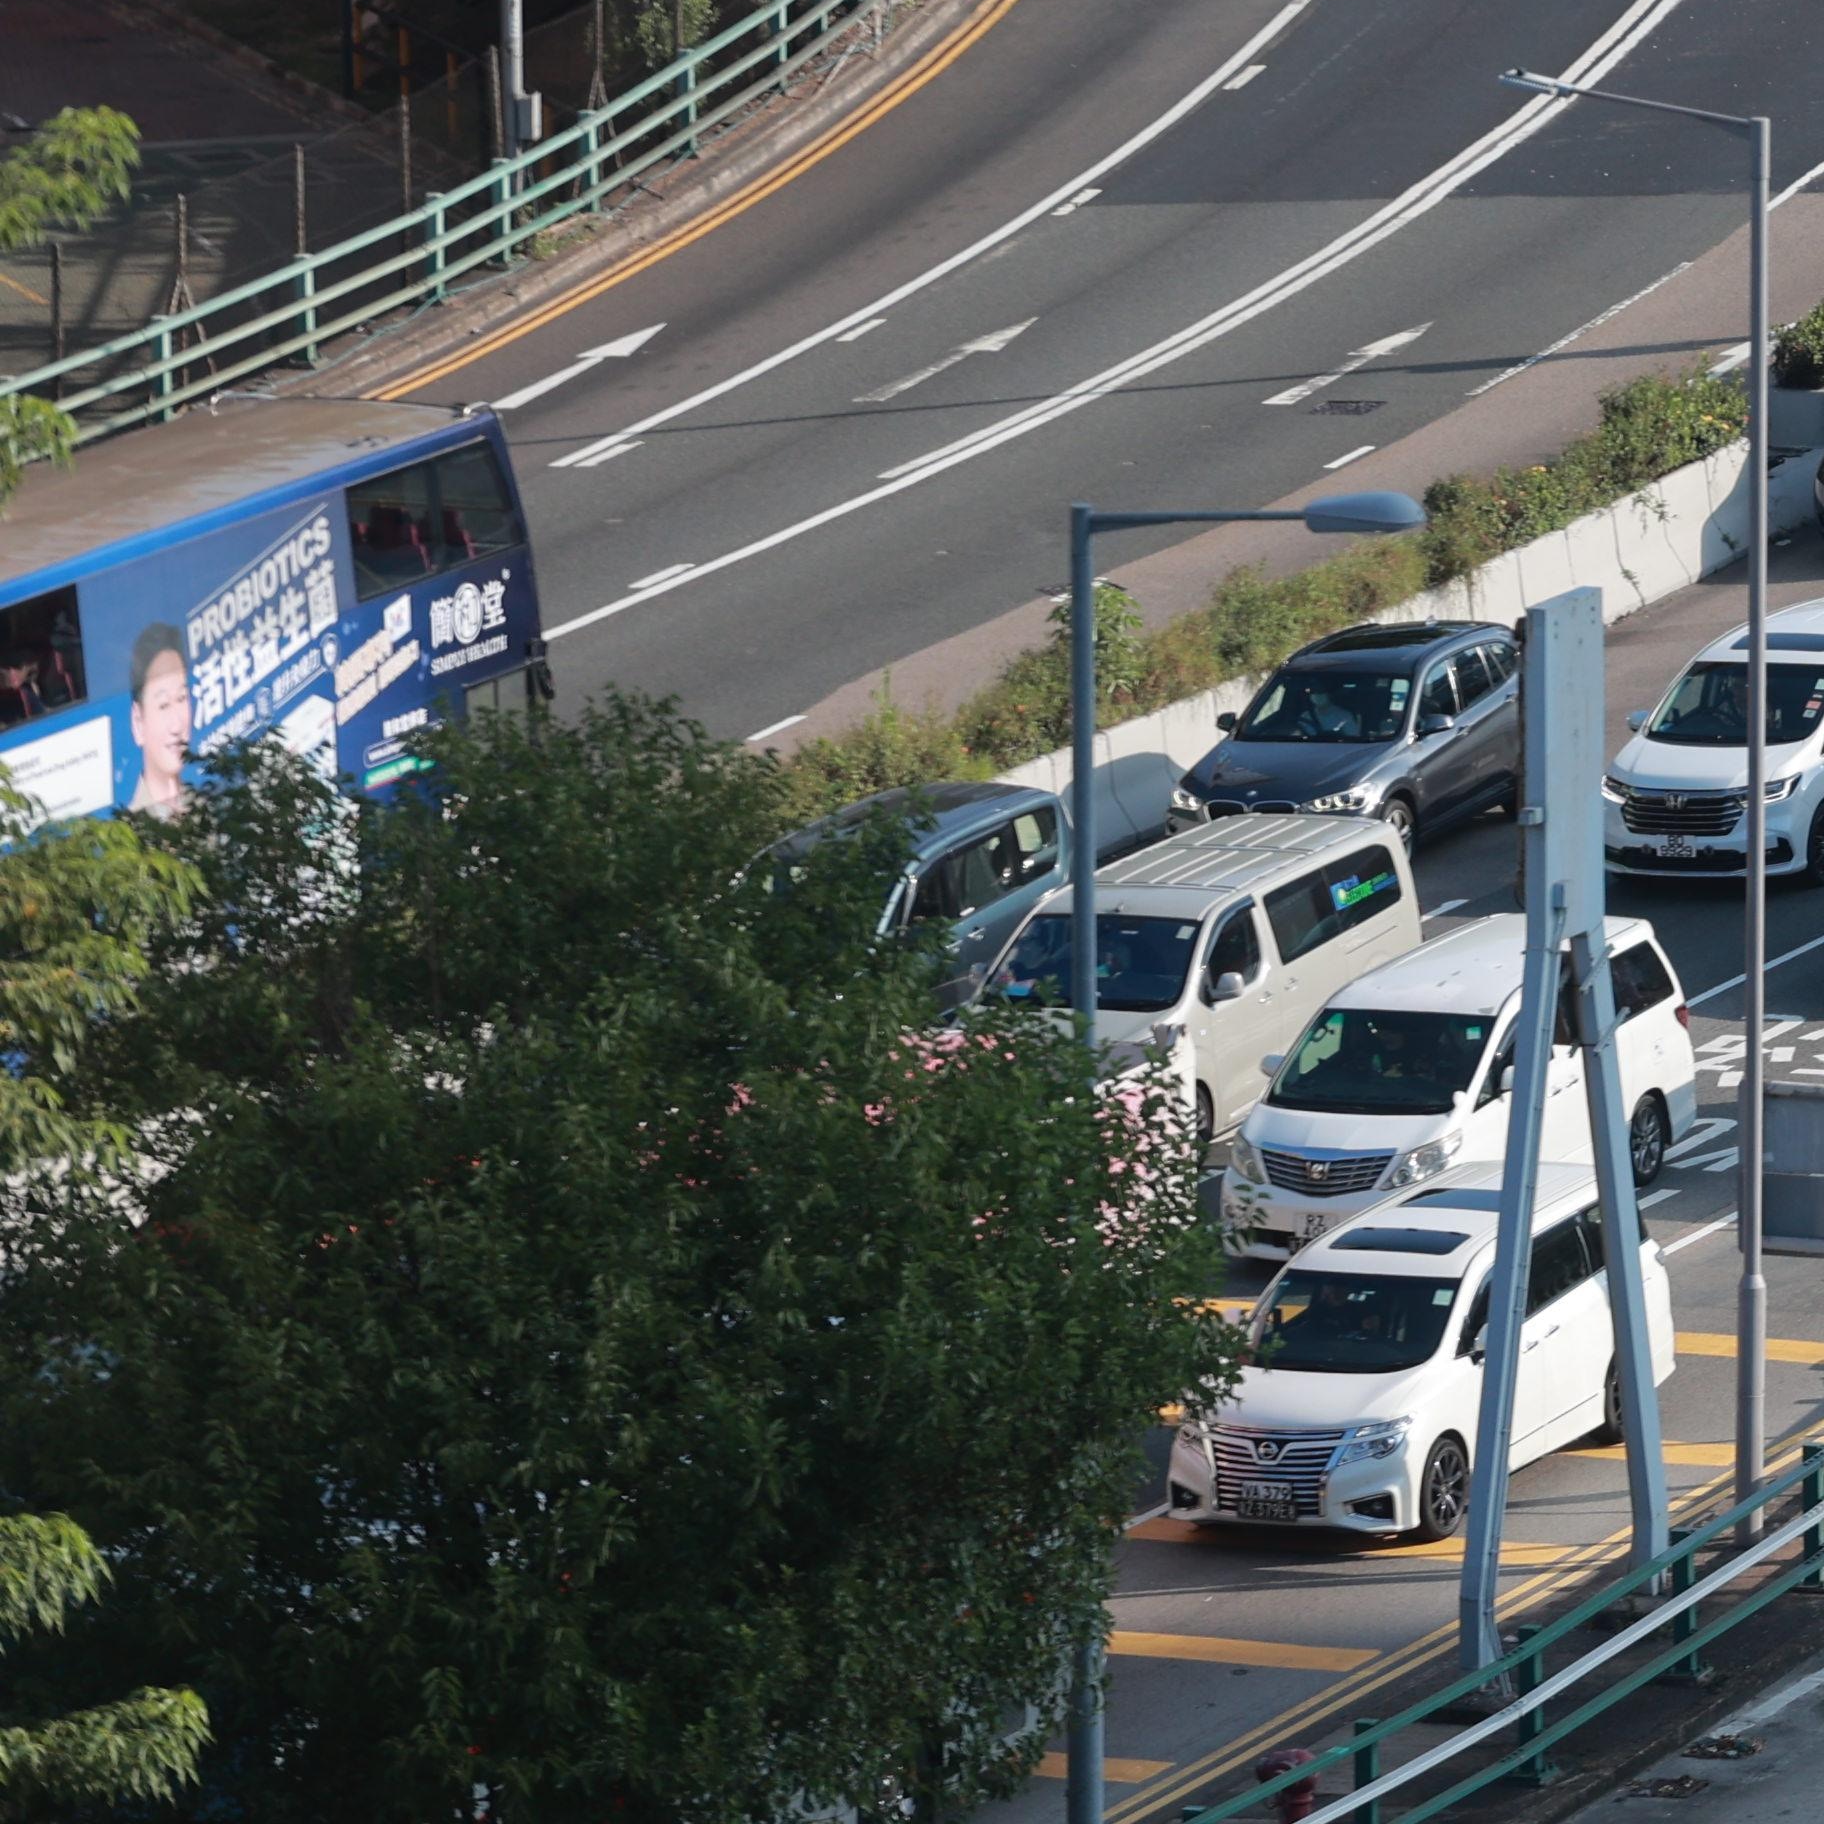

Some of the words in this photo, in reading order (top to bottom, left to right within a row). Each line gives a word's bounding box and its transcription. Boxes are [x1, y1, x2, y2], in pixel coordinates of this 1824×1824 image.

[187, 516, 332, 659] PROBIOTICS
[192, 558, 339, 730] 活性益生菌
